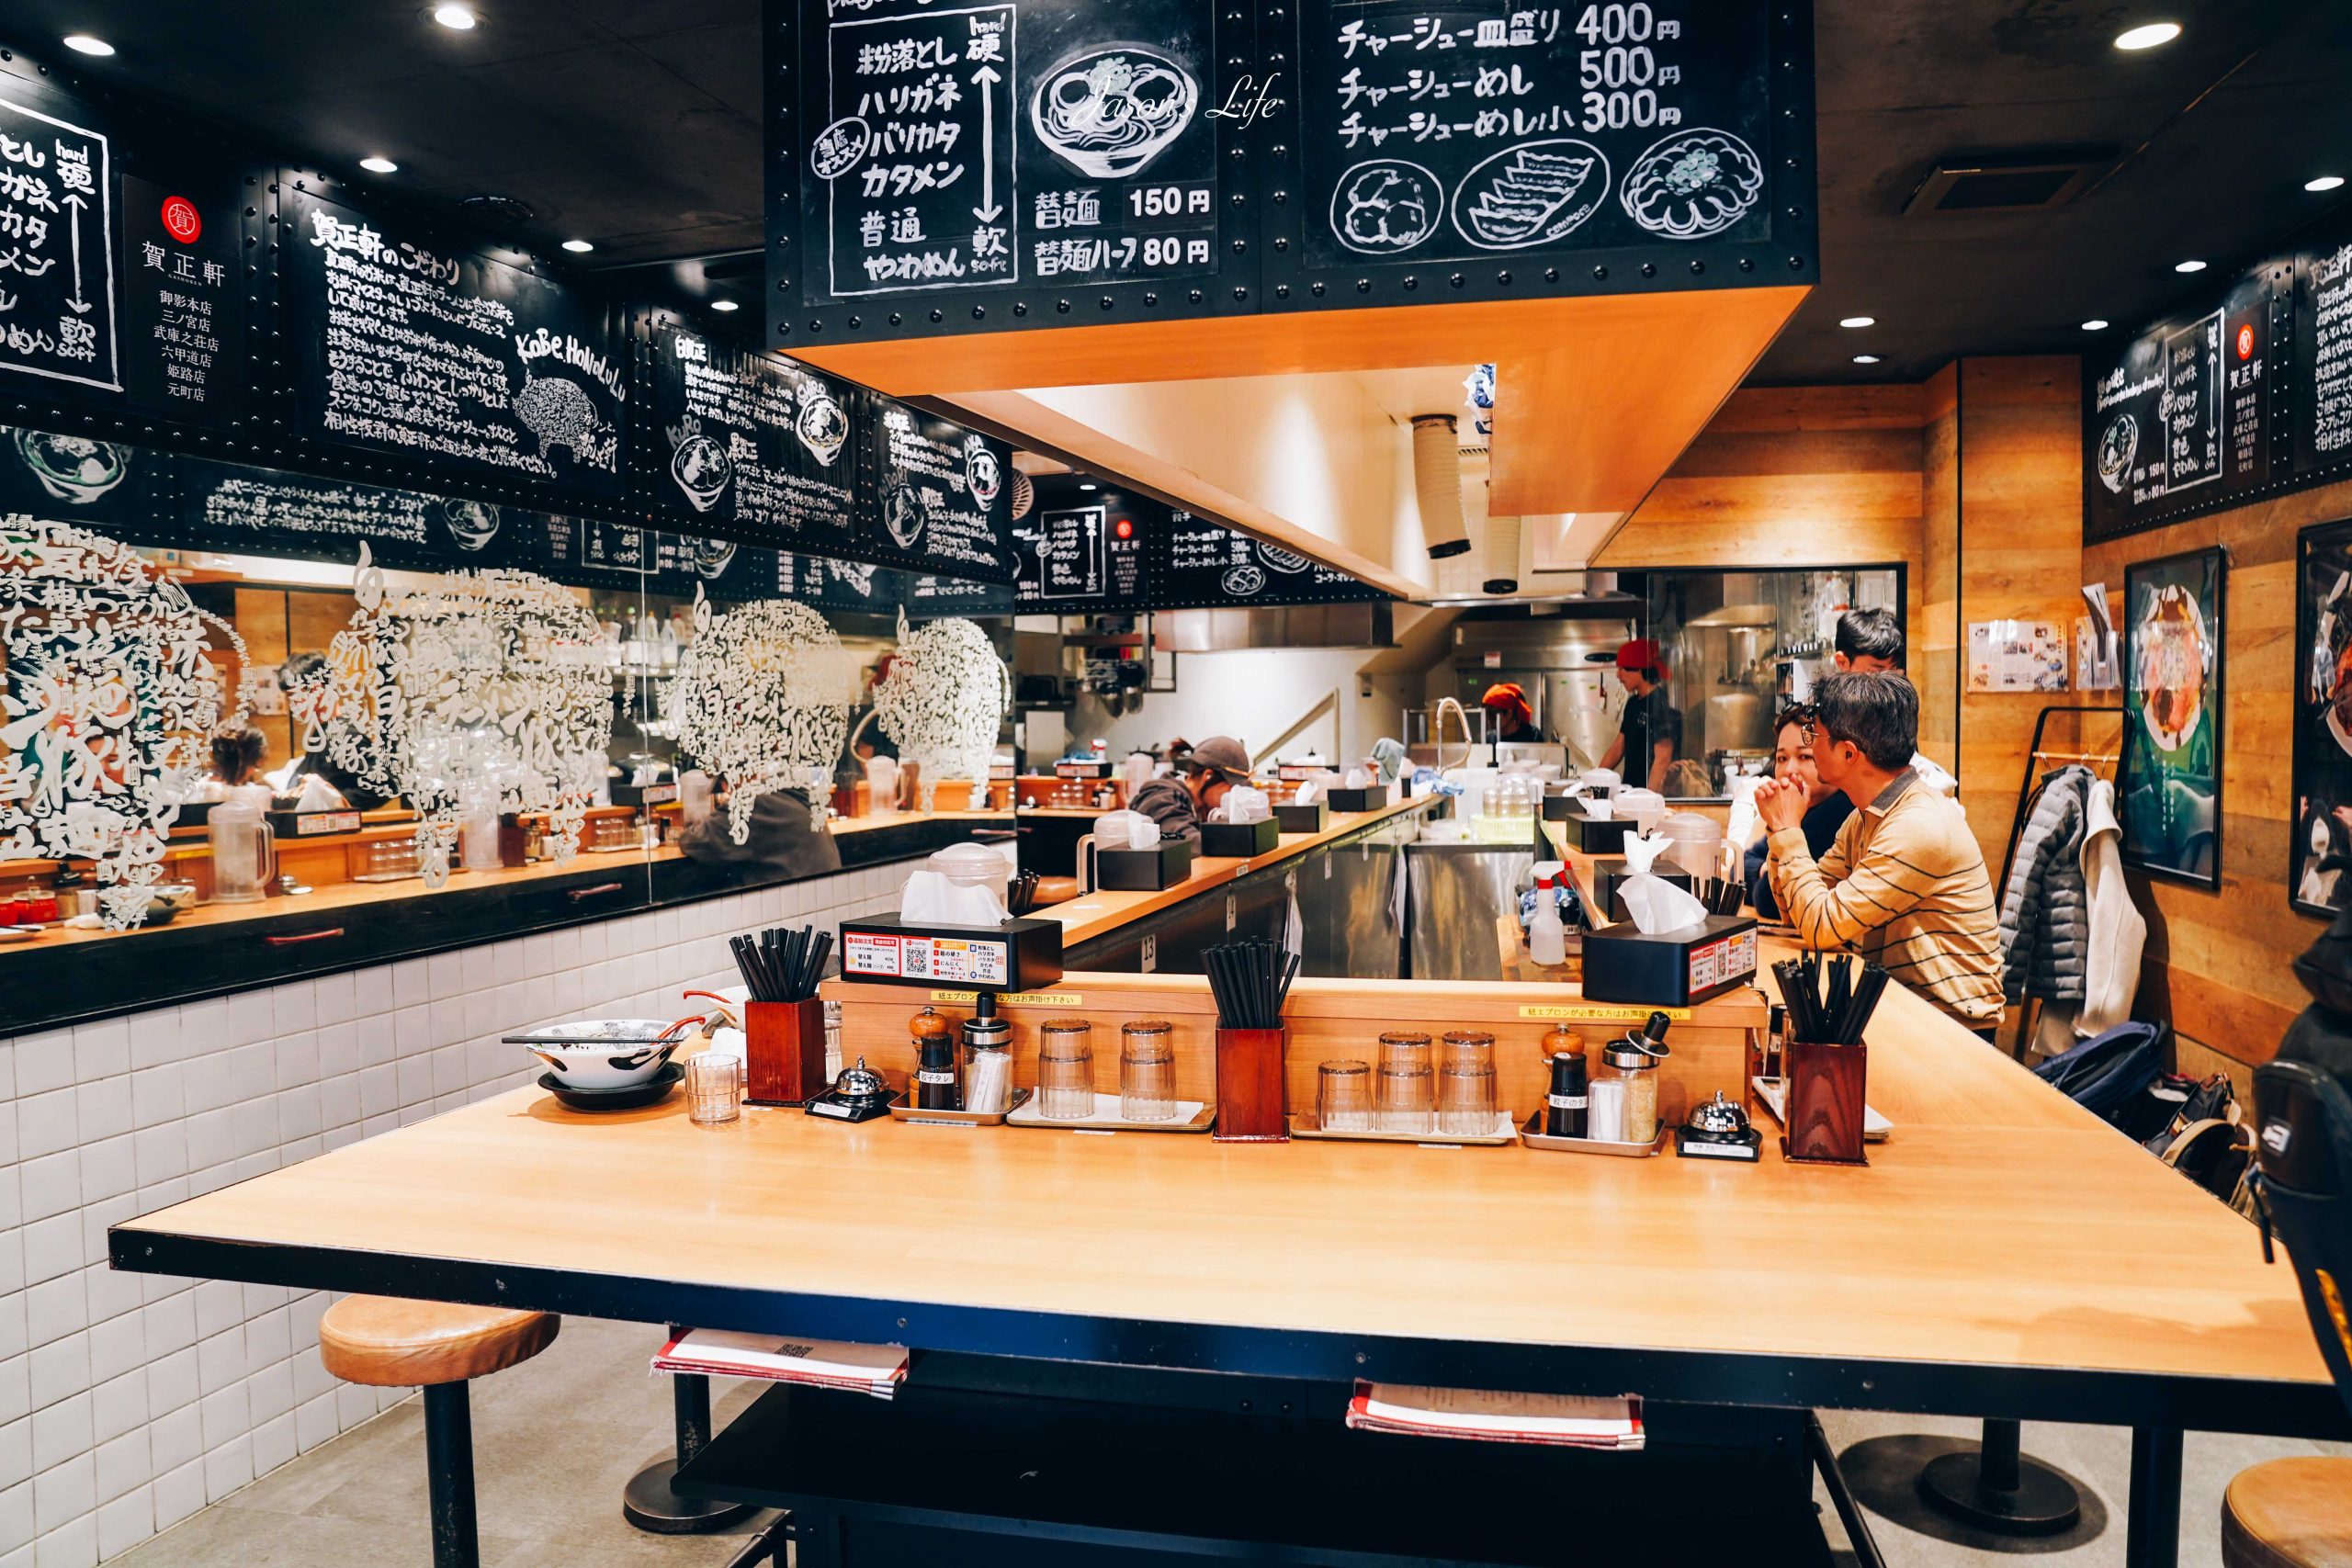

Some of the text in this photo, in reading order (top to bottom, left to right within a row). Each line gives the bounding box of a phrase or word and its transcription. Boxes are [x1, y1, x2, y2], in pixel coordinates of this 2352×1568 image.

[969, 12, 1006, 36] hard
[1338, 9, 1560, 58] チャーシュー皿盛り
[856, 37, 957, 74] 粉落とし
[966, 33, 1005, 62] 硬
[857, 73, 962, 116] ハリガネ
[1338, 63, 1533, 109] チャーシューめし
[819, 128, 848, 159] 当店
[870, 120, 961, 157] バリカタ
[1338, 106, 1575, 148] チャーシューめし小
[55, 138, 87, 164] hard
[817, 134, 863, 175] オススメ
[56, 160, 96, 195] 硬
[861, 161, 965, 197] カタメン
[1035, 188, 1102, 229] 替麺
[860, 207, 927, 247] 普通
[972, 225, 1008, 257] 軟
[311, 208, 459, 285] 賀正軒のこだわり
[141, 241, 225, 287] 賀正軒
[864, 247, 966, 281] やわめん
[159, 289, 211, 315] 御影本店
[59, 315, 96, 347] 軟
[162, 310, 210, 332] 三ノ宮店
[154, 325, 219, 353] 武庫之荘店
[162, 345, 211, 368] 六甲道店
[167, 364, 206, 384] 姫路店
[2230, 358, 2262, 391] 賀正軒
[167, 383, 205, 402] 元町店
[1144, 937, 1154, 961] 13
